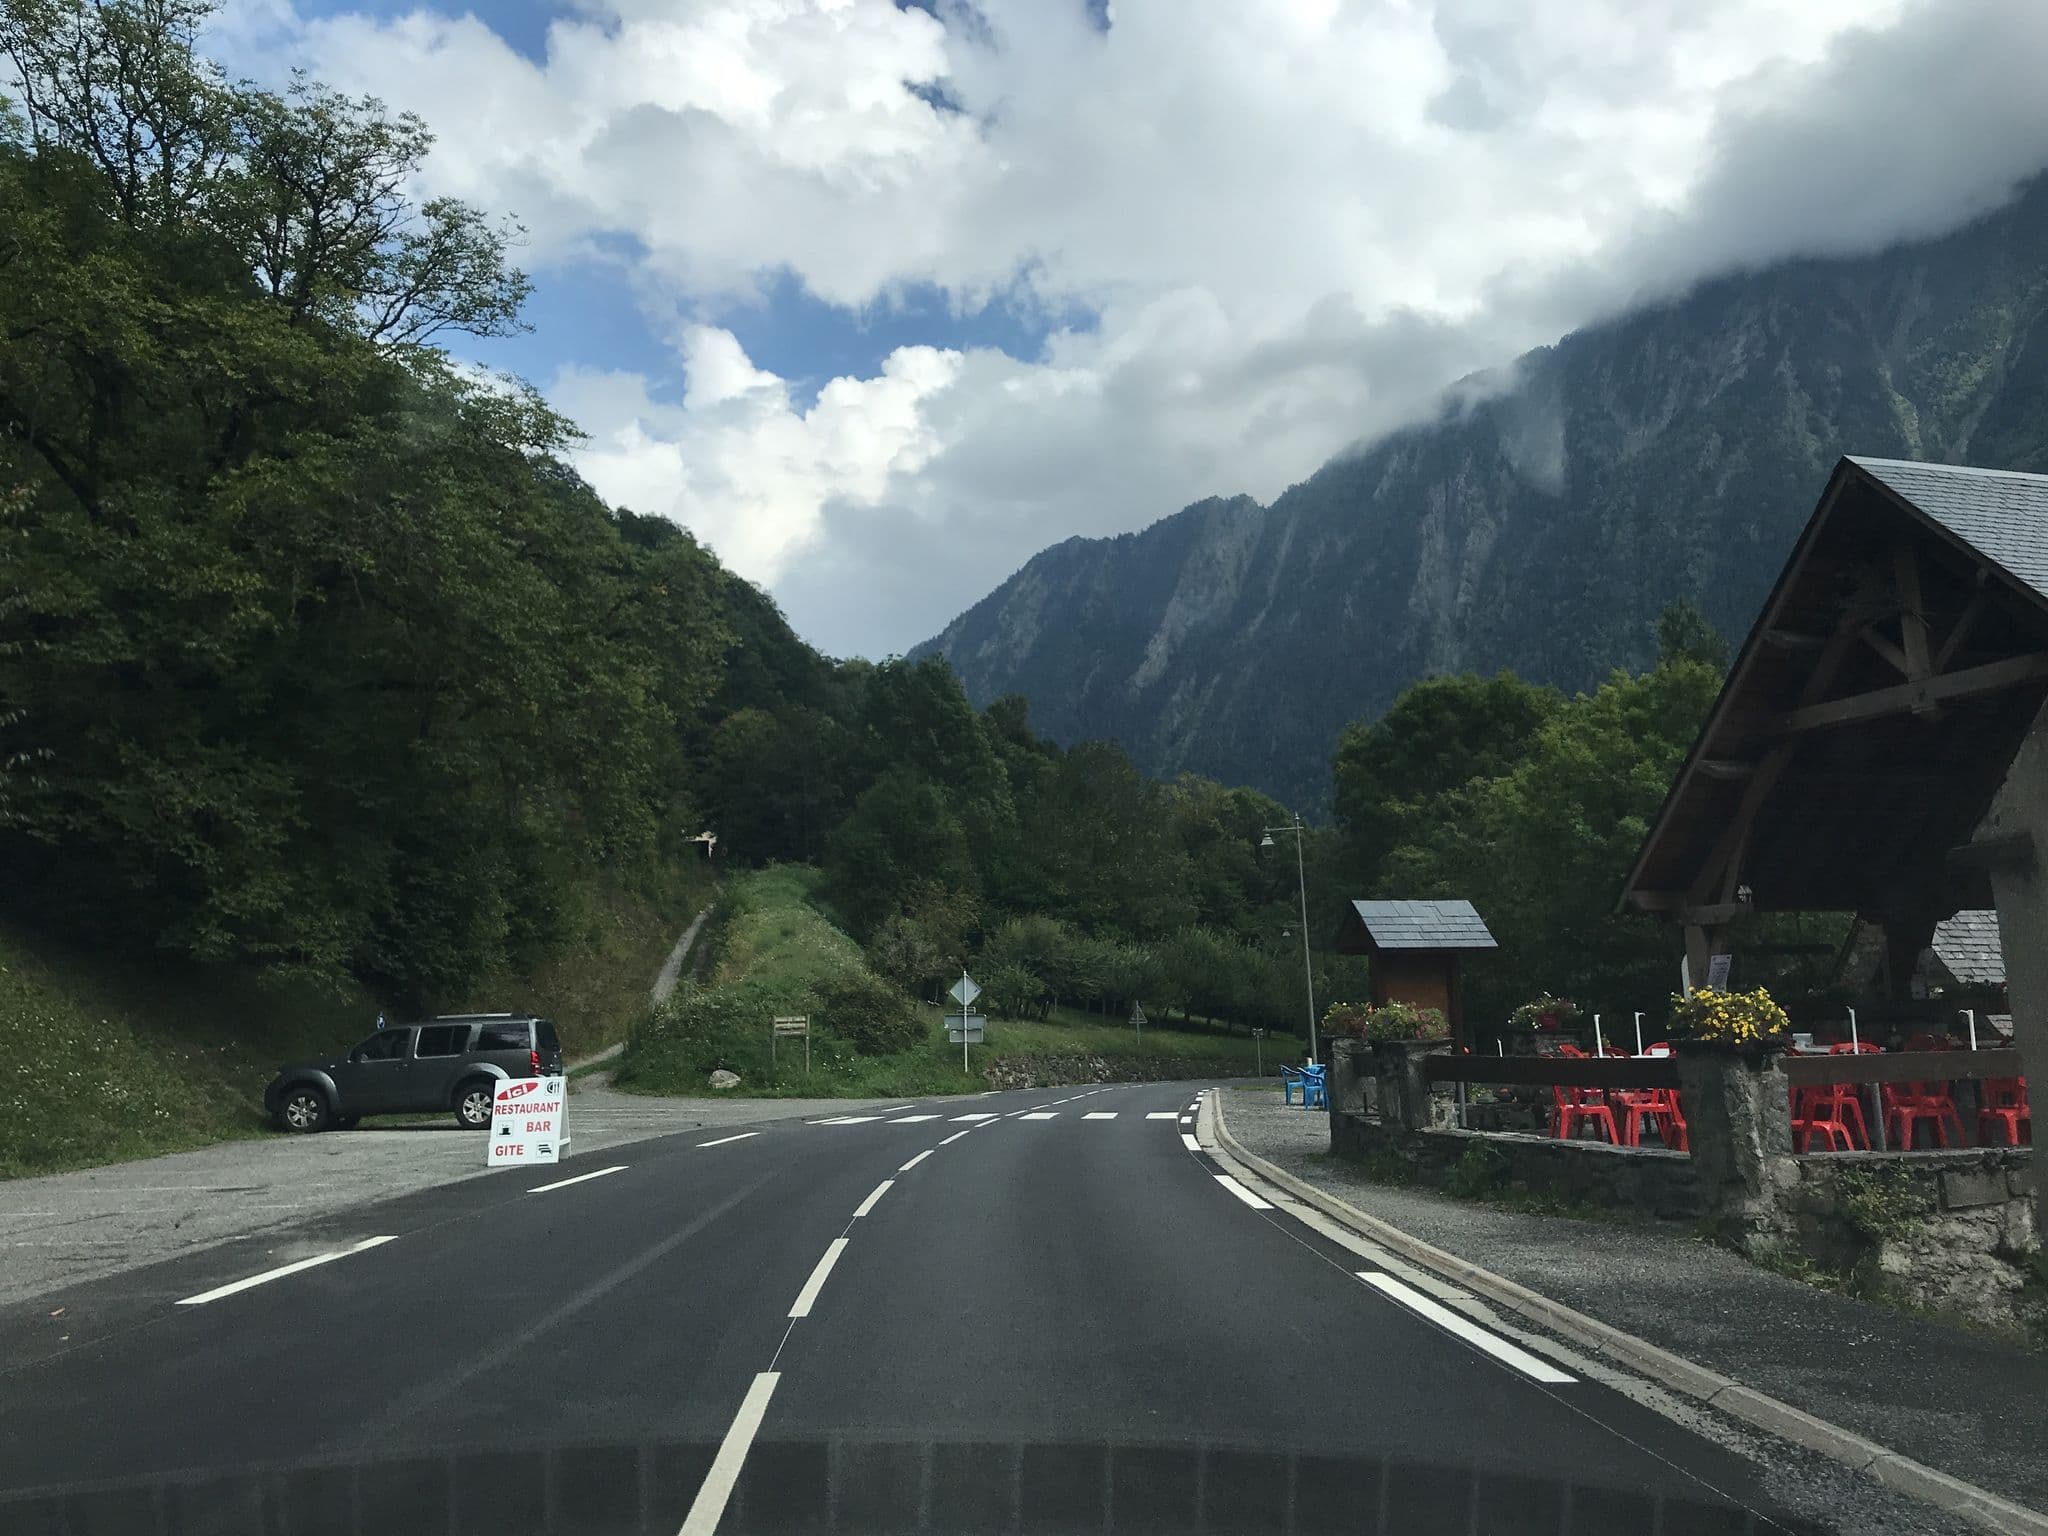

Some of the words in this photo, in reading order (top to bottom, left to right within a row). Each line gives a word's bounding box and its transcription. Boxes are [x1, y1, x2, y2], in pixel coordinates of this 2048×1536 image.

[495, 1102, 560, 1115] RESTAURANT
[526, 1121, 551, 1132] BAR
[495, 1145, 524, 1156] GITE
